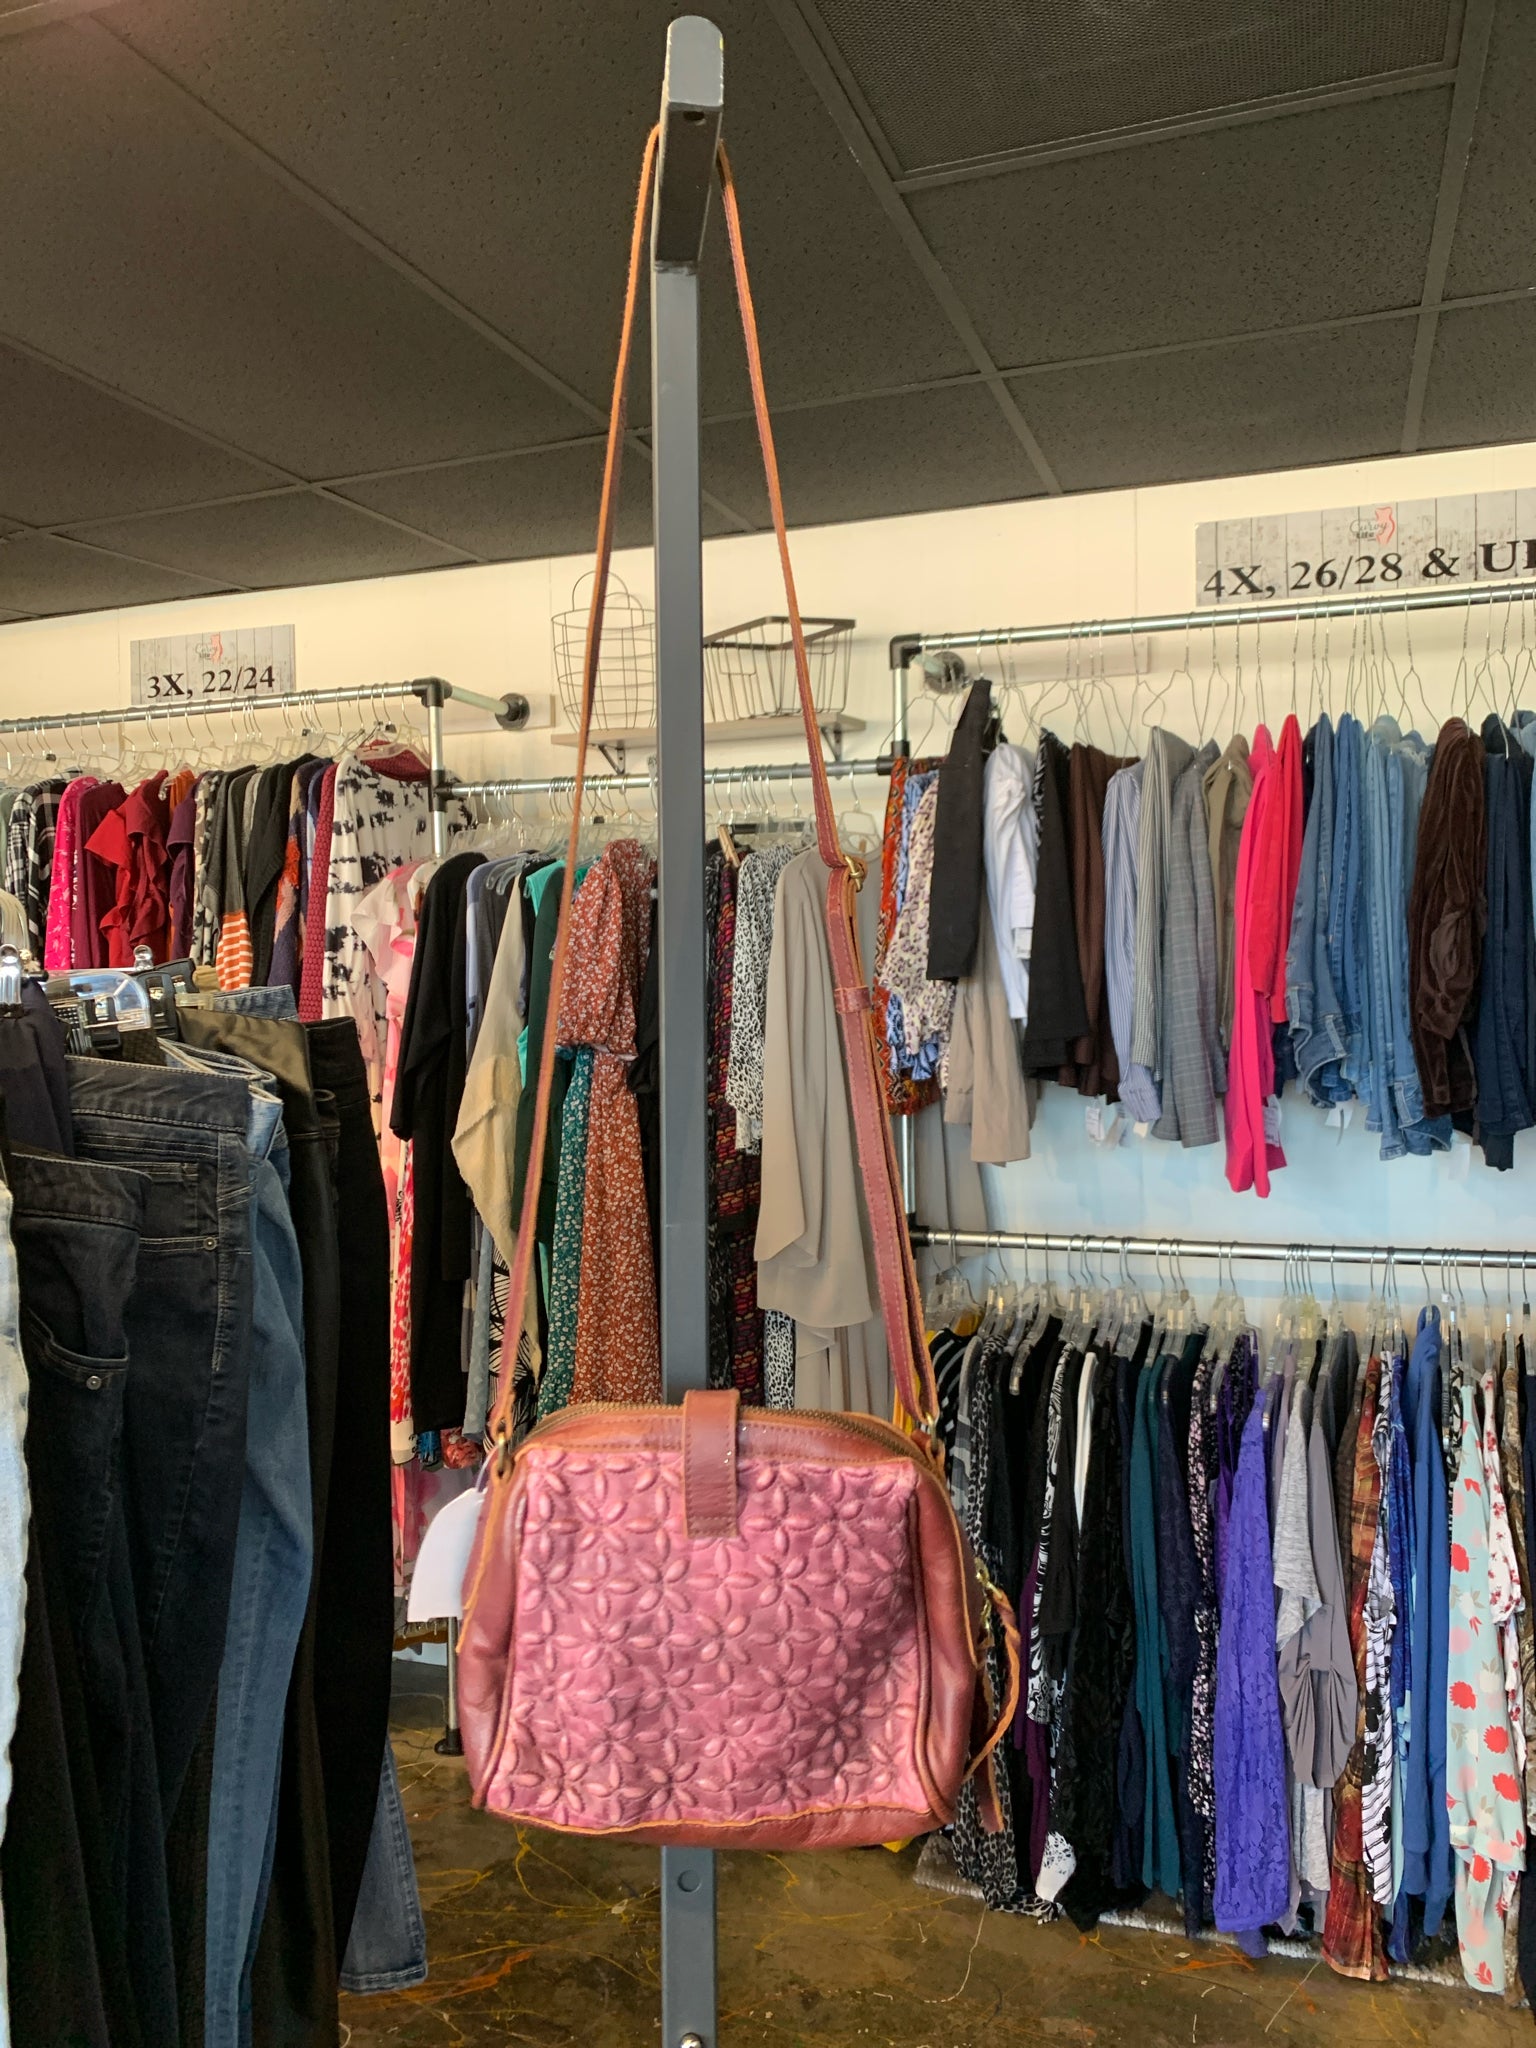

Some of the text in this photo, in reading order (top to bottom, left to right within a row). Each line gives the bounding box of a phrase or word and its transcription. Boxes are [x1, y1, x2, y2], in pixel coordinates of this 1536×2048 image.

[1204, 564, 1275, 597] 4X,
[1291, 553, 1403, 590] 26/28
[1422, 547, 1460, 578] &
[147, 666, 275, 700] 3X, 22/24
